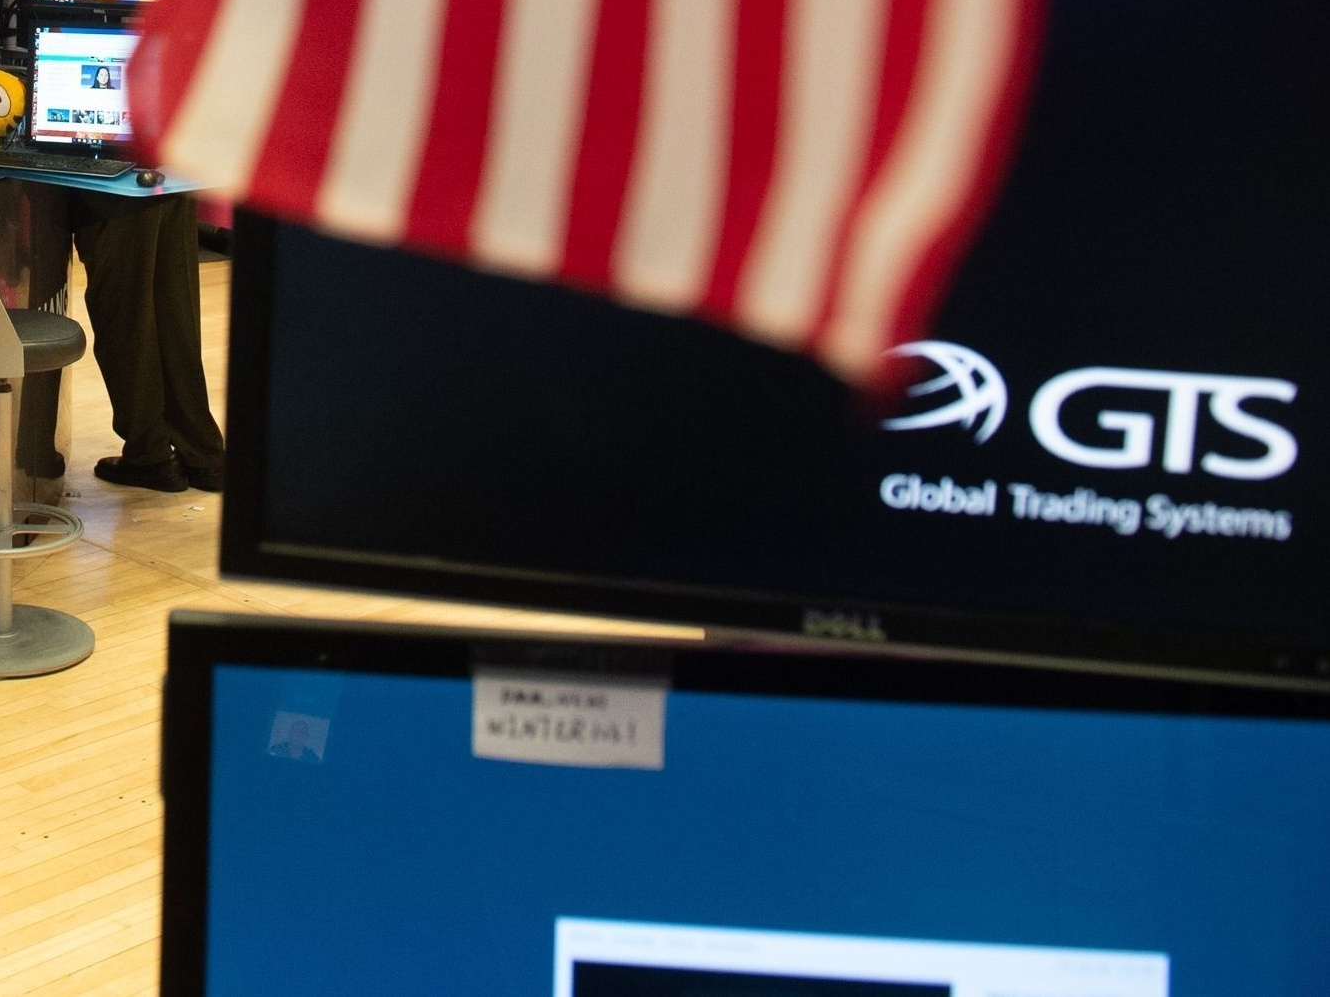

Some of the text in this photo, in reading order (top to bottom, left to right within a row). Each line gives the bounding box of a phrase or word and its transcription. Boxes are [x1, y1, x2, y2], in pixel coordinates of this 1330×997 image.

[1030, 366, 1298, 480] GTS
[879, 474, 1292, 541] Global Trading Systems
